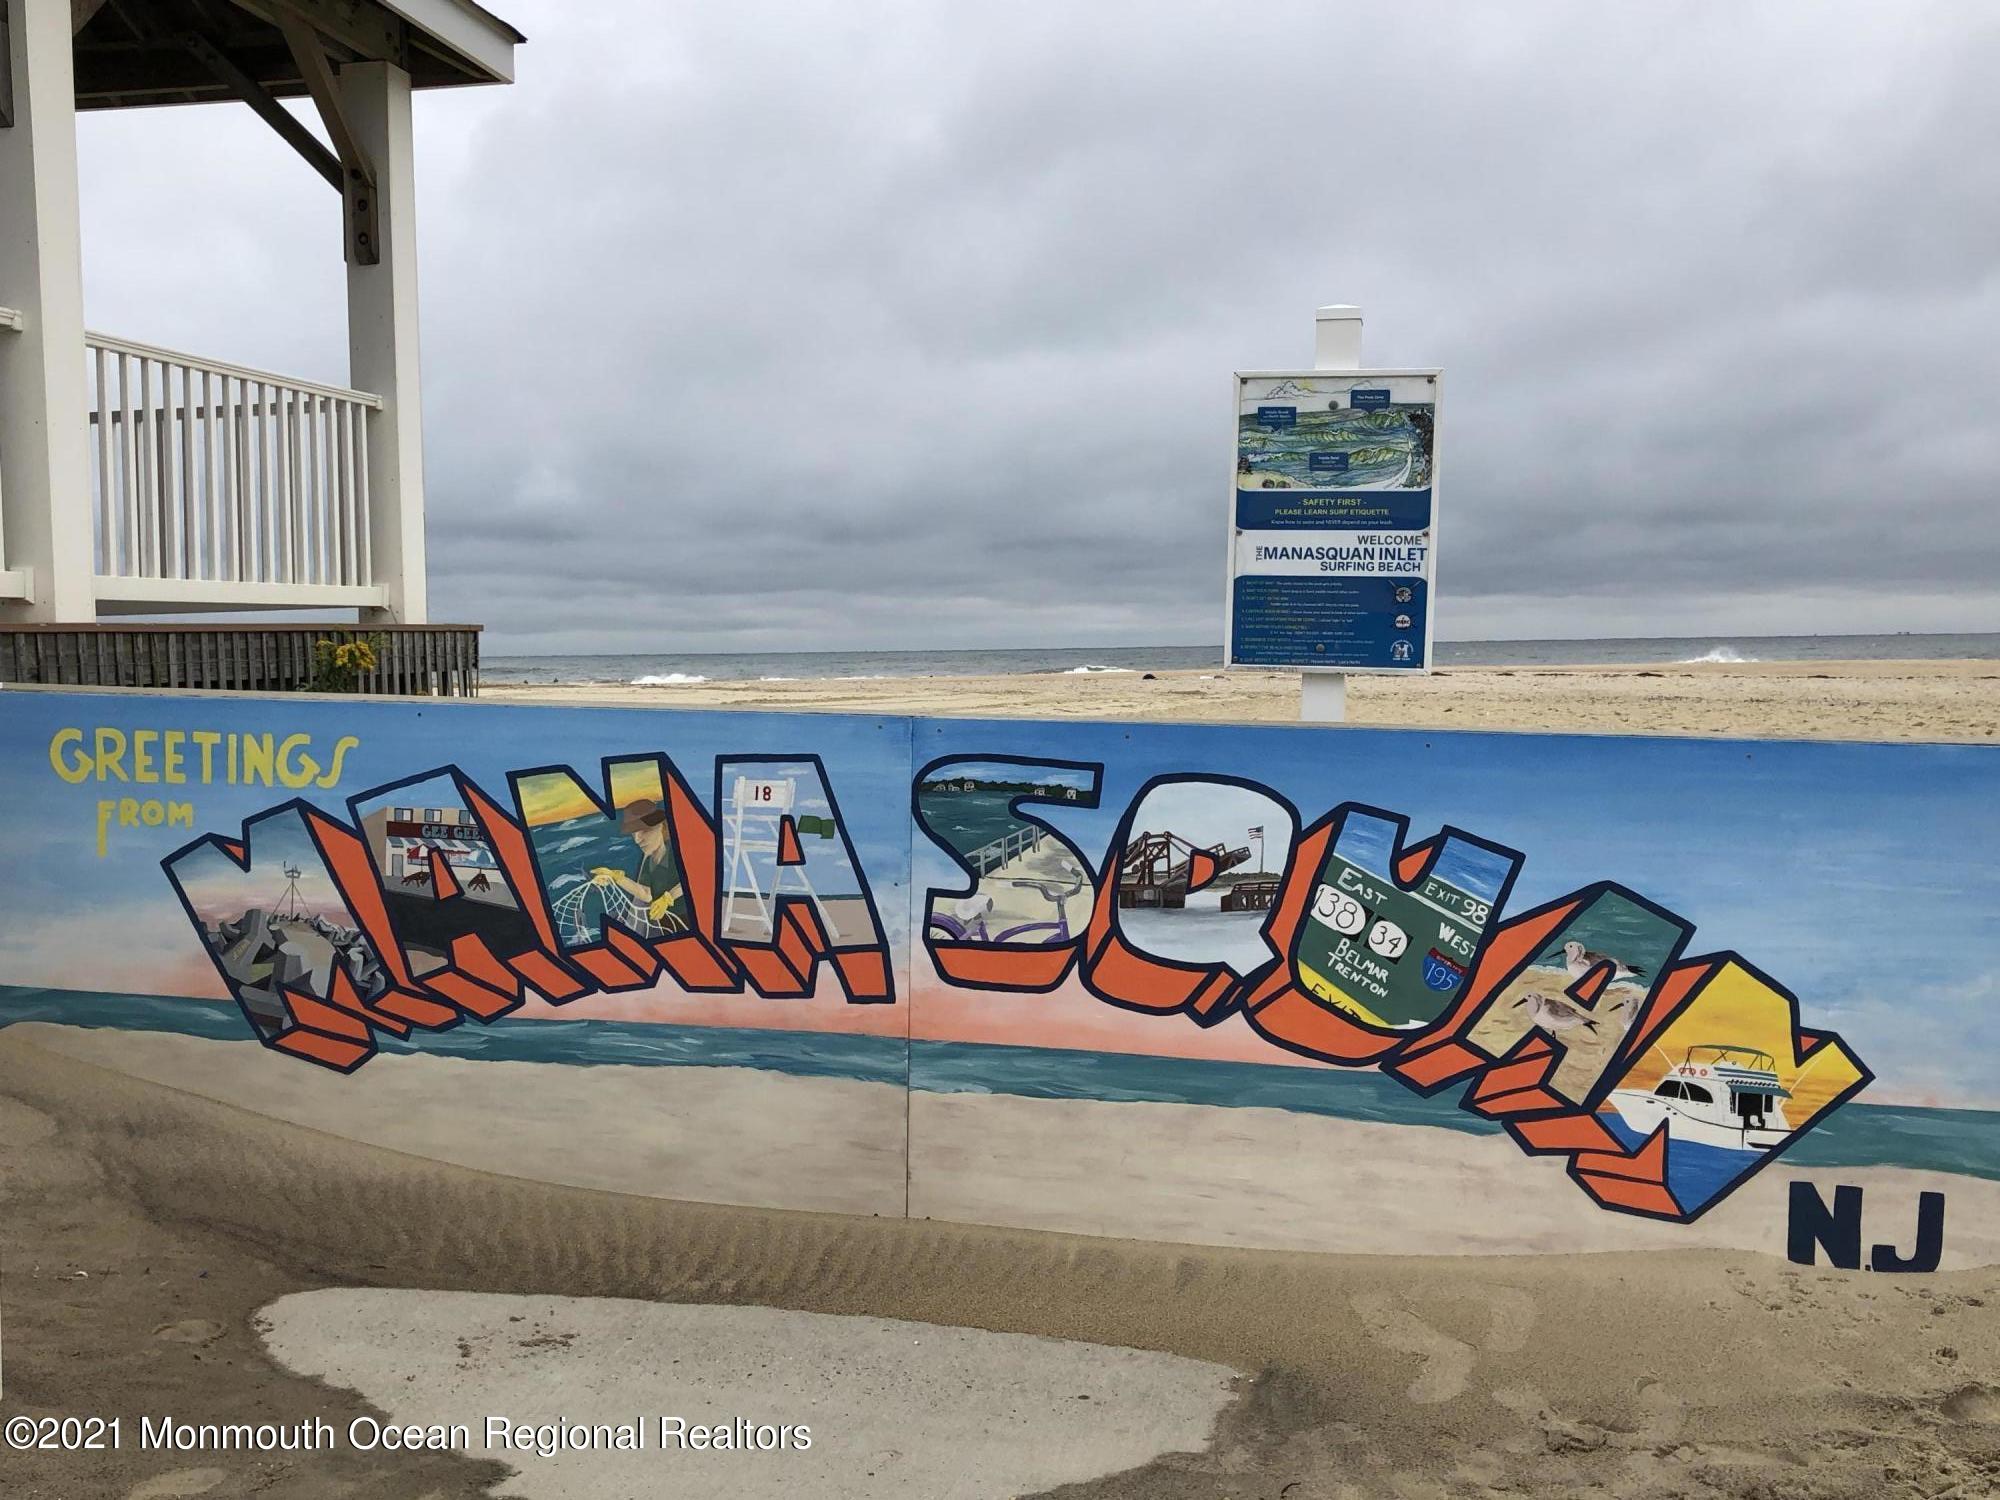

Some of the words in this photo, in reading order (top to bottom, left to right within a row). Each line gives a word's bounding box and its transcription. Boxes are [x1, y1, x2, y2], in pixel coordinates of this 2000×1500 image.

[1302, 498, 1334, 506] SAFETY
[1337, 498, 1362, 506] FIRST
[1349, 508, 1390, 516] ETIQUETTE
[1263, 547, 1375, 561] MANASQUAN
[1379, 547, 1427, 561] INLET
[1358, 535, 1422, 546] WELCOME
[1320, 561, 1375, 572] SURFING
[1378, 562, 1421, 572] BEACH
[49, 727, 360, 789] GREETINGS
[754, 785, 772, 801] 18
[97, 798, 194, 858] FROM
[421, 824, 449, 838] GEE
[453, 826, 484, 840] GEE
[1337, 867, 1388, 905] EAST
[1312, 887, 1358, 929] 138
[1424, 881, 1459, 906] EXIT
[1460, 900, 1489, 926] 98
[1370, 925, 1402, 954] 34
[1438, 921, 1476, 959] WEST
[1327, 951, 1388, 998] TRENTON
[1334, 937, 1389, 984] BELMAR
[1425, 963, 1458, 990] 195
